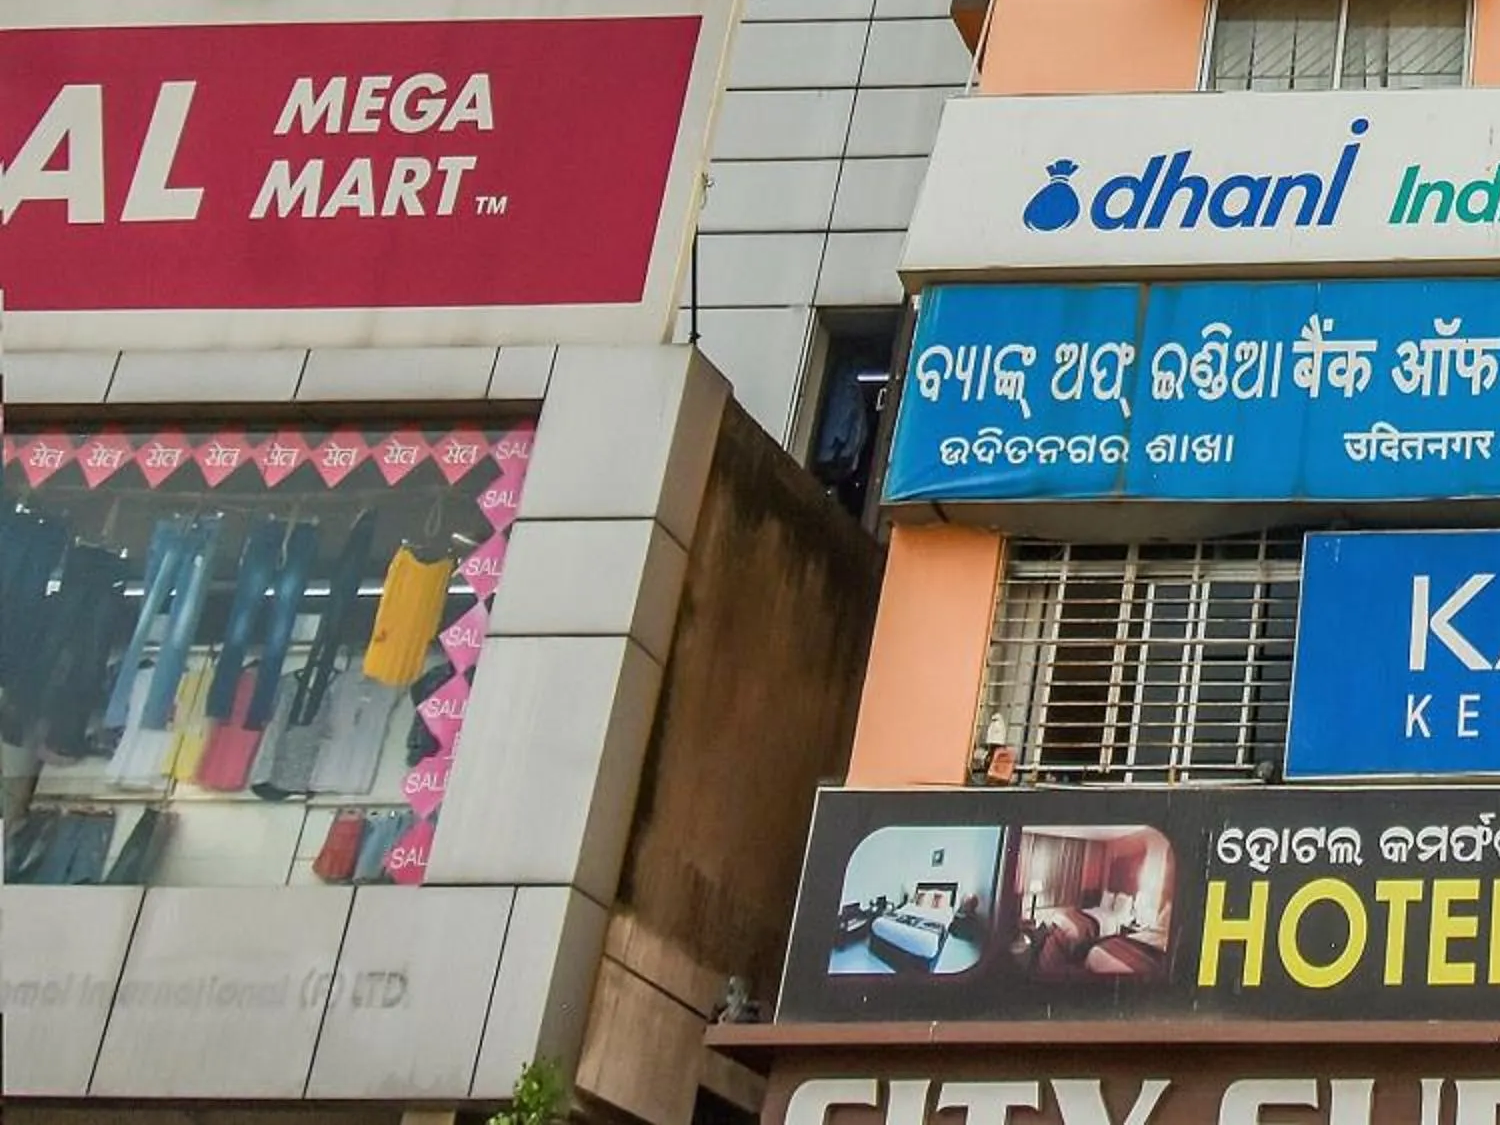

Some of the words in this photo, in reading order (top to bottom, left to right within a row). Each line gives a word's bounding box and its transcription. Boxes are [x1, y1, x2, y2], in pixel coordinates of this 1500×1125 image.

[273, 73, 494, 134] MEGA
[0, 81, 204, 224] AL
[249, 156, 477, 220] MART
[1090, 118, 1369, 230] dhani
[1292, 314, 1378, 398] बैंक
[1343, 421, 1495, 460] उदितनगर
